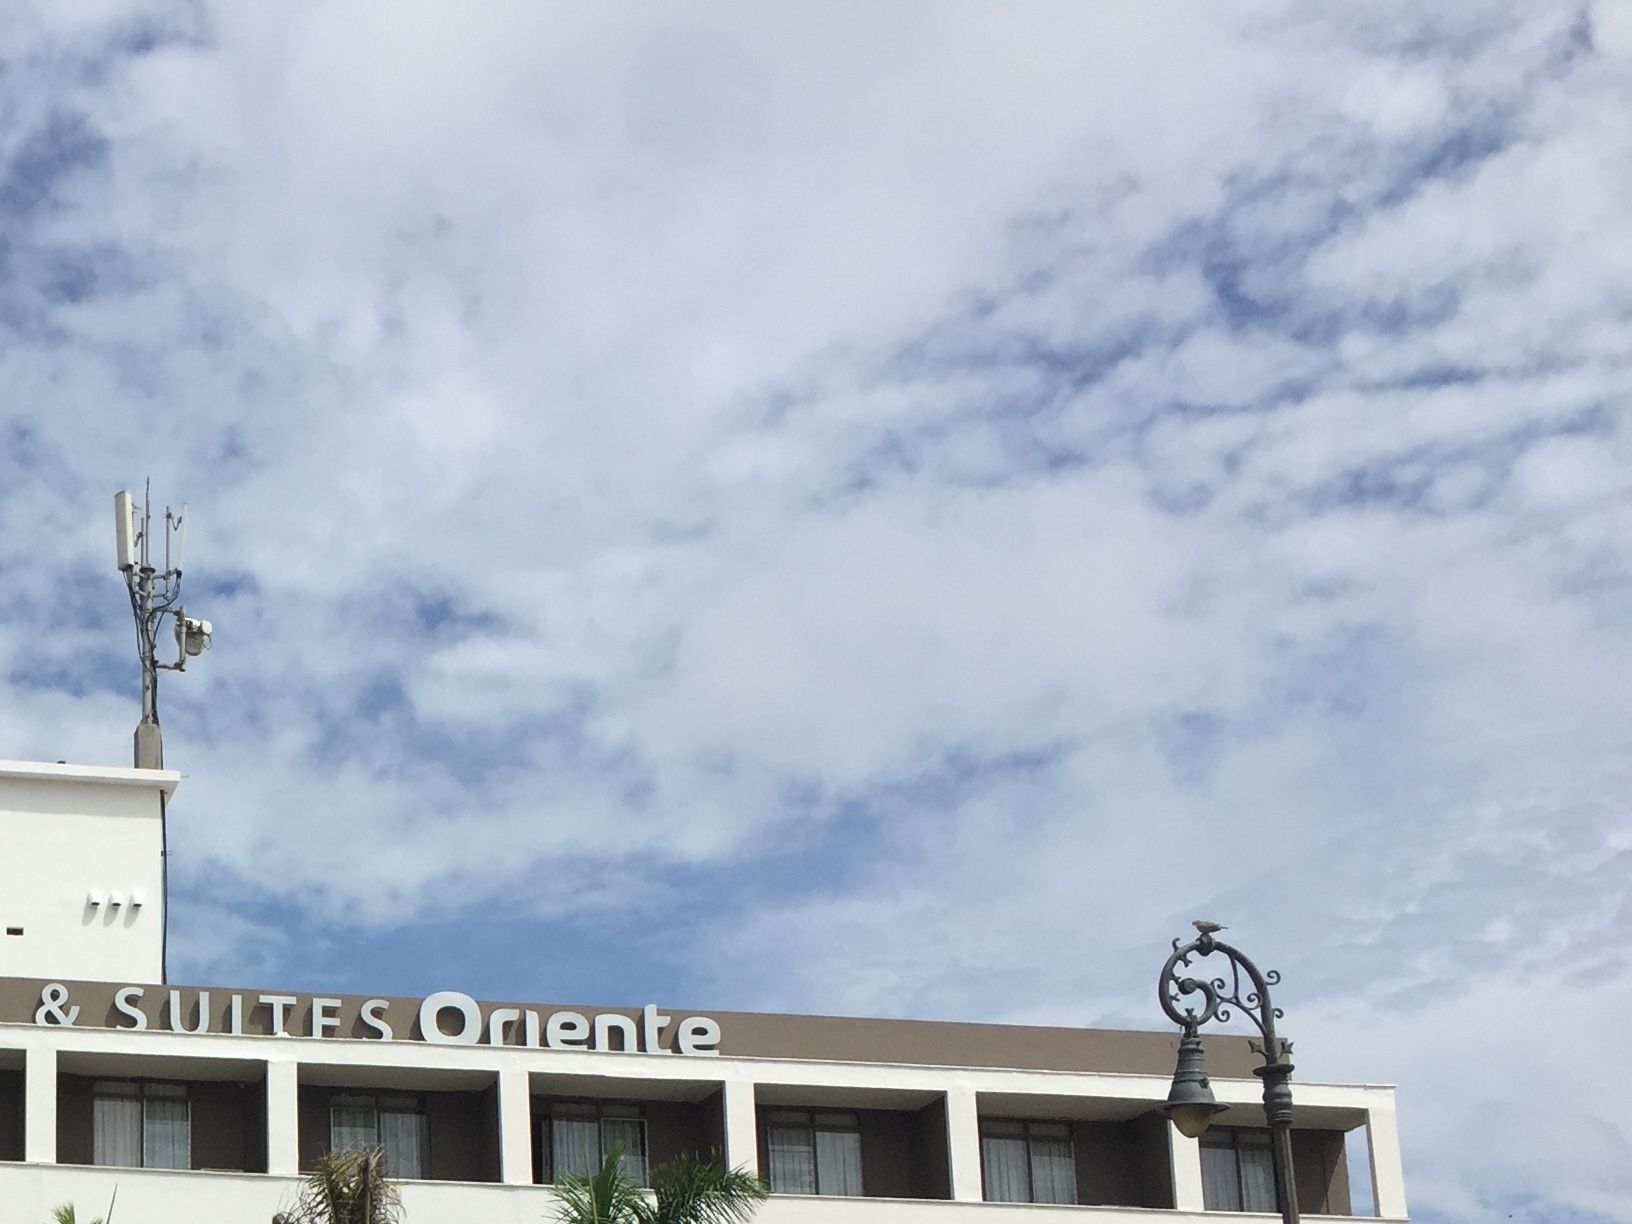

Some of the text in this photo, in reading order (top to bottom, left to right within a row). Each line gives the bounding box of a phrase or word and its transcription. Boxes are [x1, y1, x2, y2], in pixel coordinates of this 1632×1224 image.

[35, 982, 79, 1027] &
[115, 986, 393, 1040] SUITES
[419, 991, 721, 1057] Oriente
